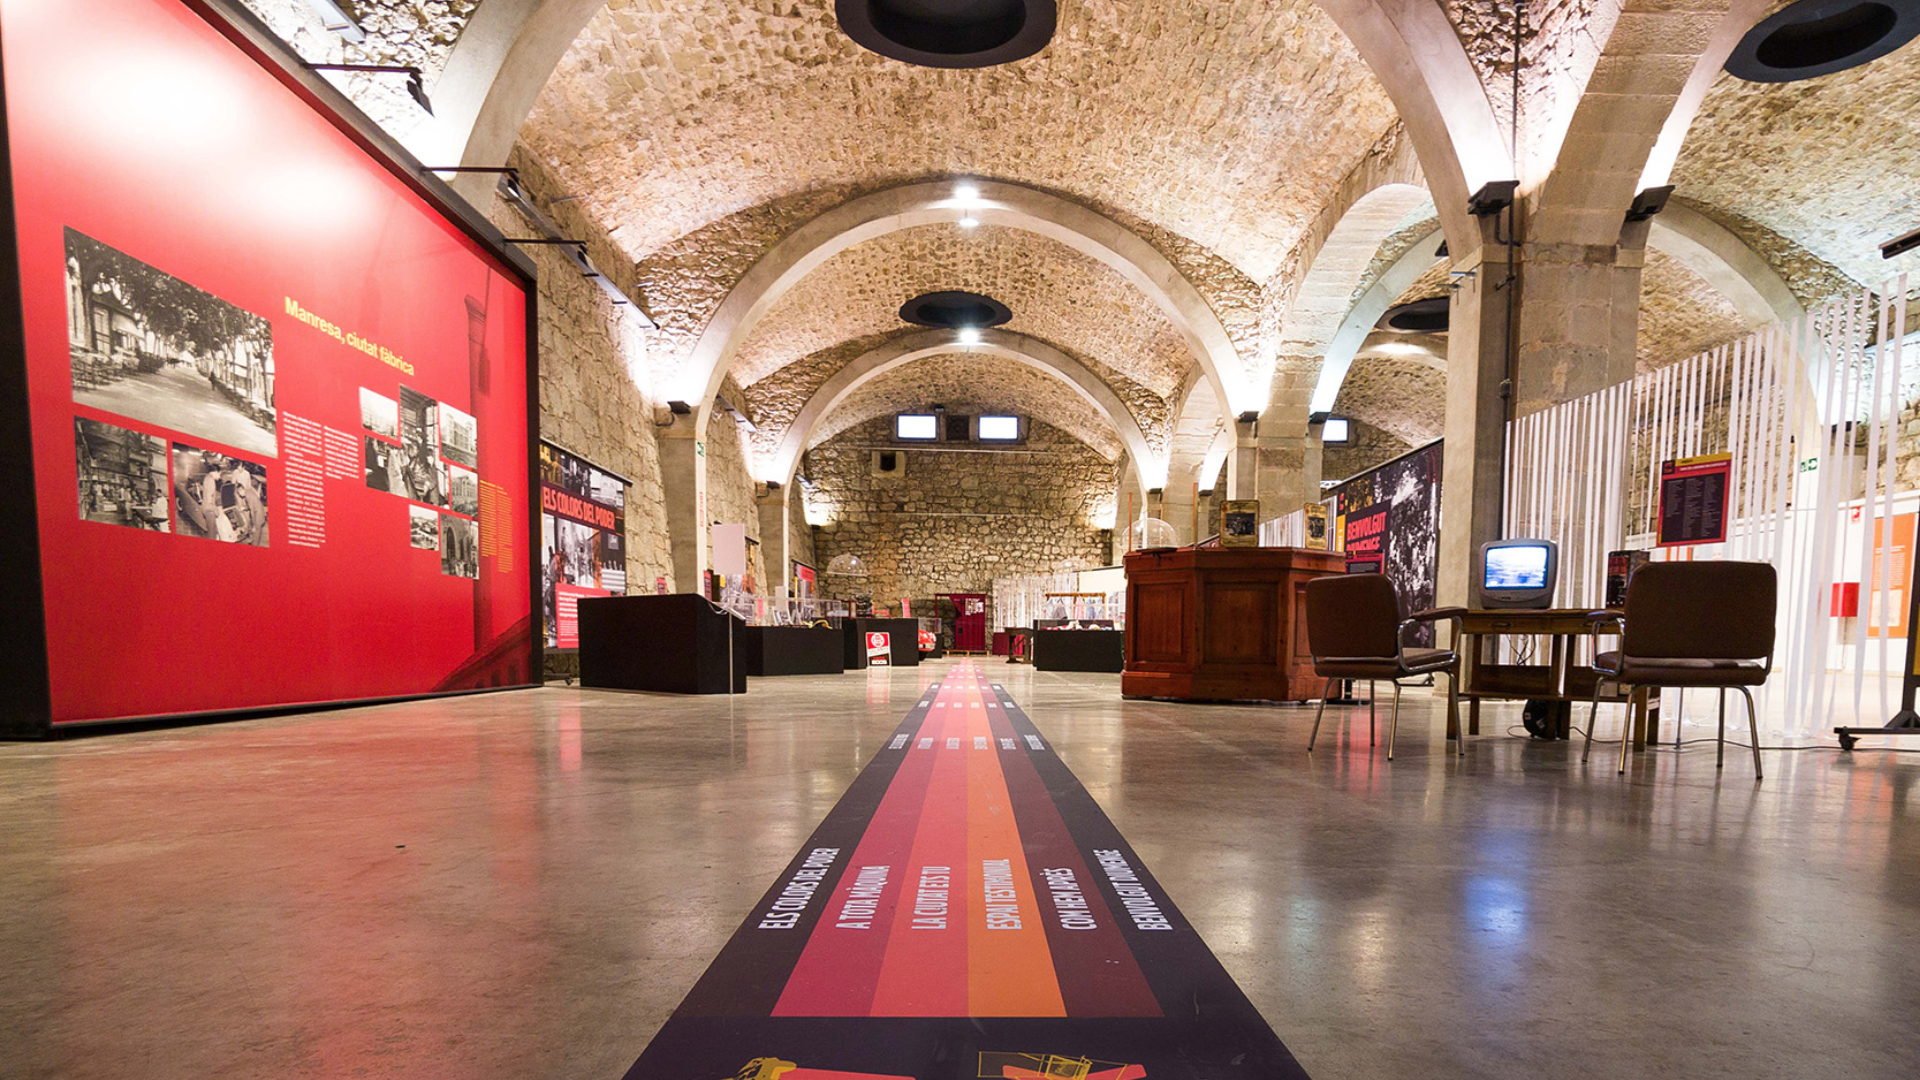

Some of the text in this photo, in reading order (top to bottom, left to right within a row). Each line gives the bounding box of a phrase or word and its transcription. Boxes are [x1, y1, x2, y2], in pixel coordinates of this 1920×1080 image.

[285, 296, 415, 376] Manresa, ciutat fàbrica
[542, 486, 615, 530] ELS COLORS DEL PODER
[1347, 511, 1387, 541] BENVOLGUT
[758, 847, 840, 929] ELS COLORS DEL PODER
[835, 865, 890, 930] A TOTA MÀQUINA
[911, 866, 951, 930] LA CIUTAT ETS TU
[982, 859, 1022, 930] ESPAI TESTIMONIAL
[1039, 867, 1098, 930] COM HEM APRÈS
[1092, 849, 1173, 930] BENVOLGUT DIUMENGE
